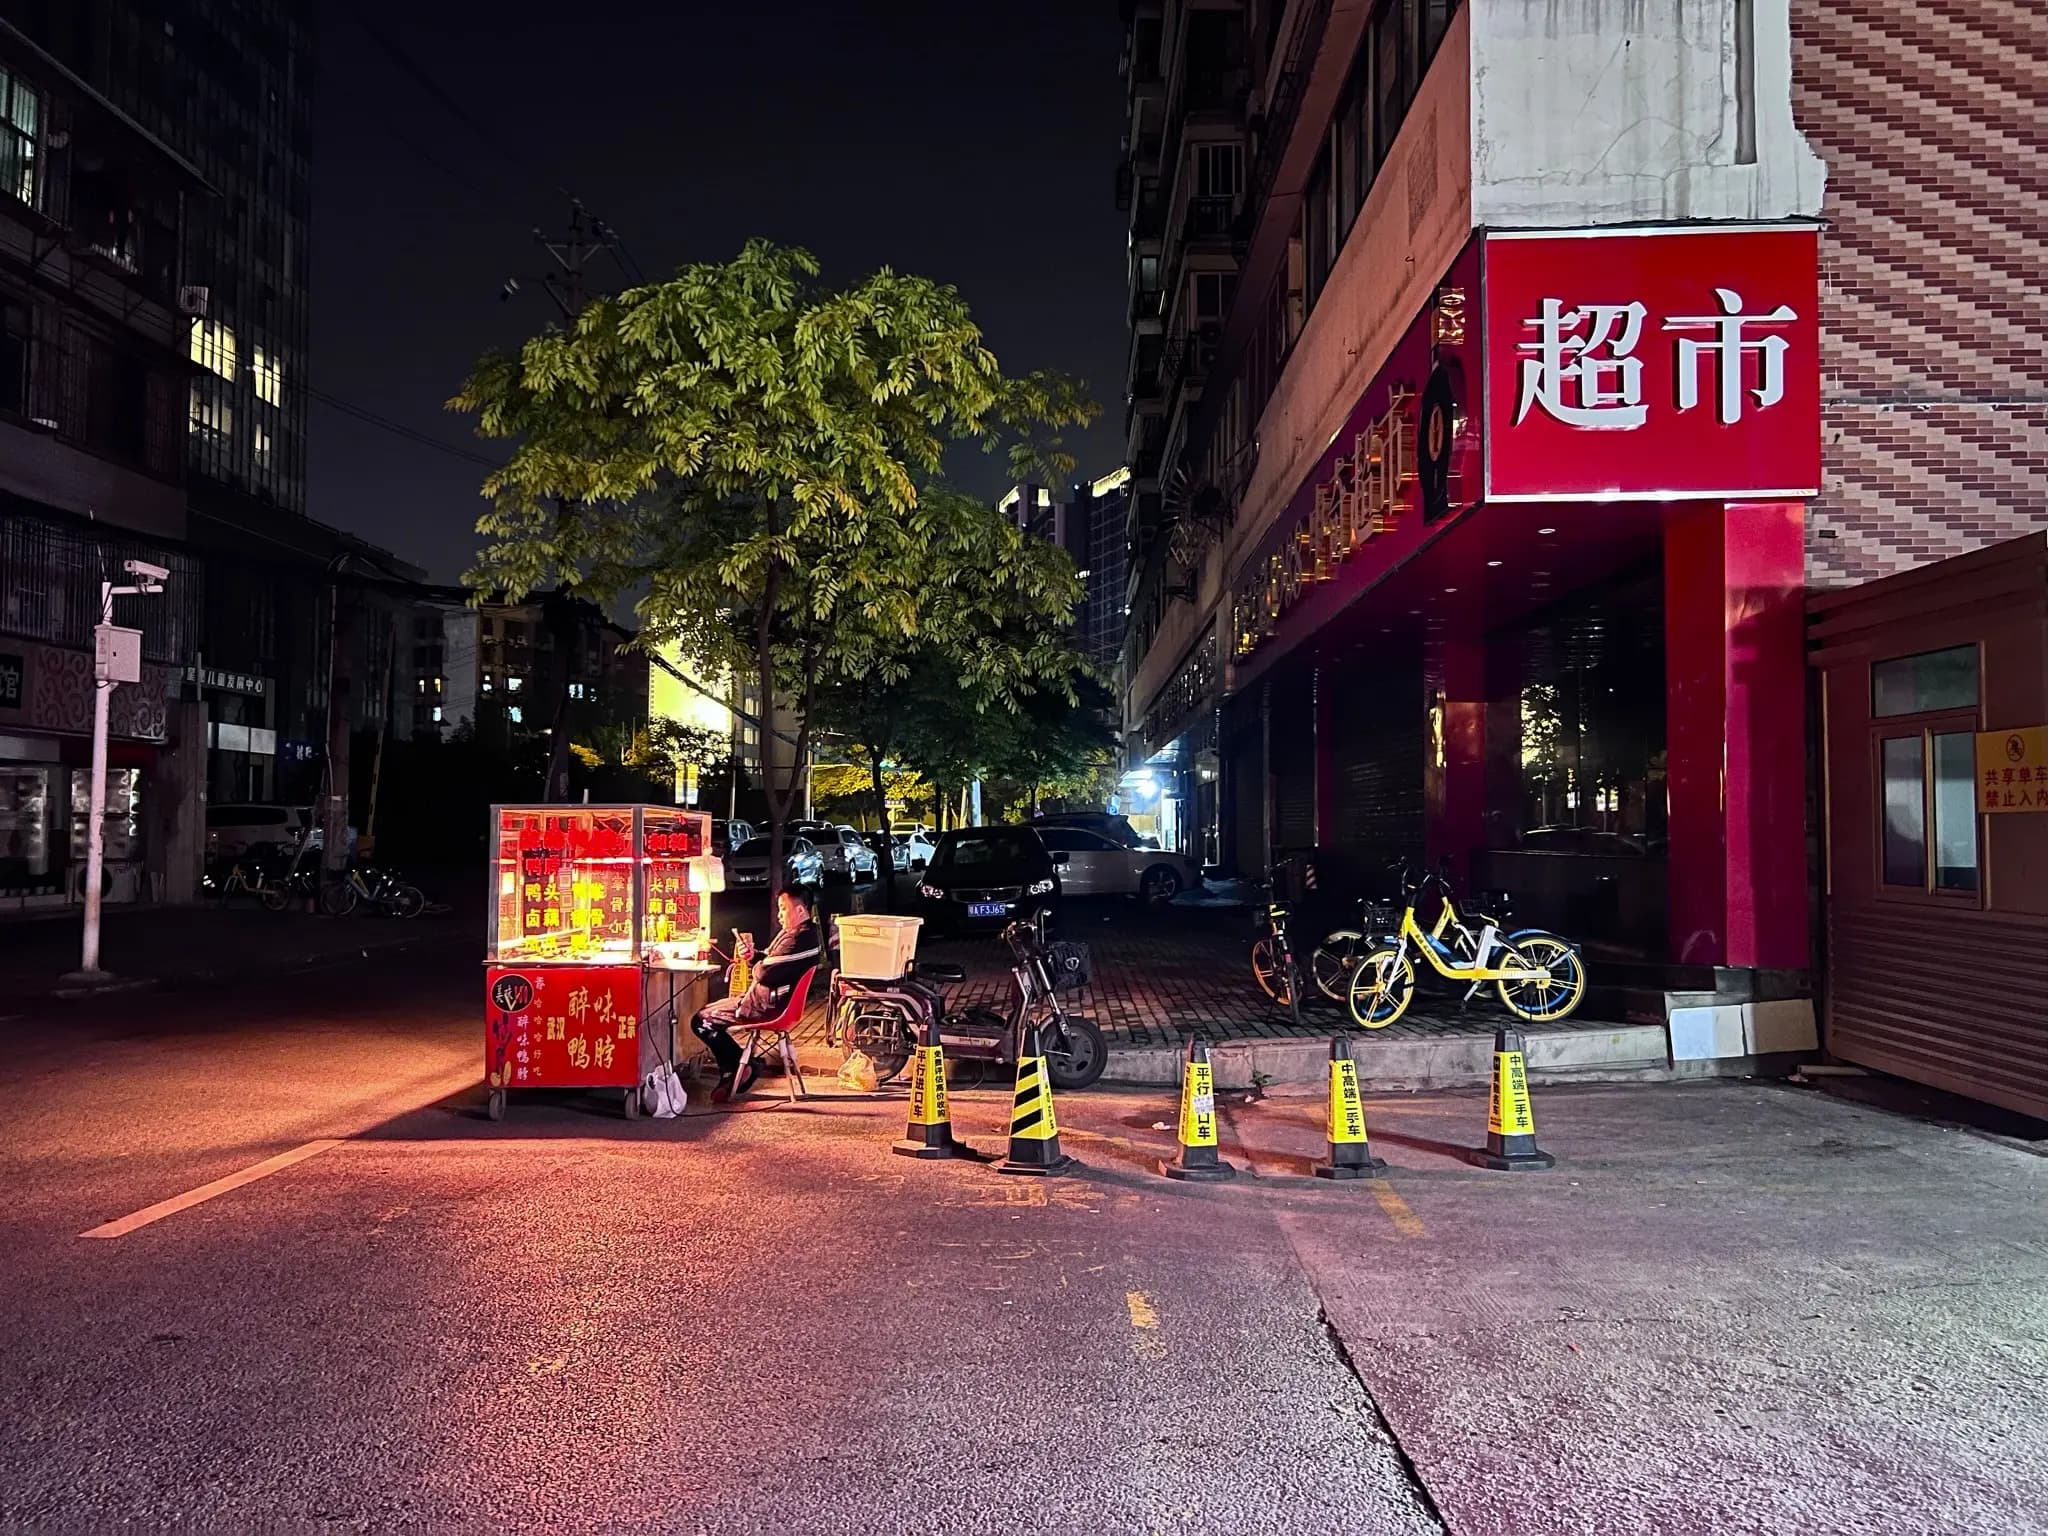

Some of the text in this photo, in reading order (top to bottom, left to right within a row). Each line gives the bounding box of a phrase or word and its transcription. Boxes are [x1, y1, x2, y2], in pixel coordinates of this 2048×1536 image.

[1511, 287, 1799, 431] 超市
[1985, 766, 2048, 787] 共享单车
[1985, 790, 2048, 808] 禁止入内
[568, 986, 617, 1025] 醉味
[546, 1016, 566, 1041] 武汉
[617, 1015, 636, 1039] 正宗
[567, 1033, 616, 1069] 鸭脖
[913, 1050, 927, 1118] 平行进口车
[1196, 1067, 1211, 1140] 平行口车
[1341, 1063, 1361, 1137] 中高端二手车
[1509, 1054, 1529, 1128] 中高端二手车
